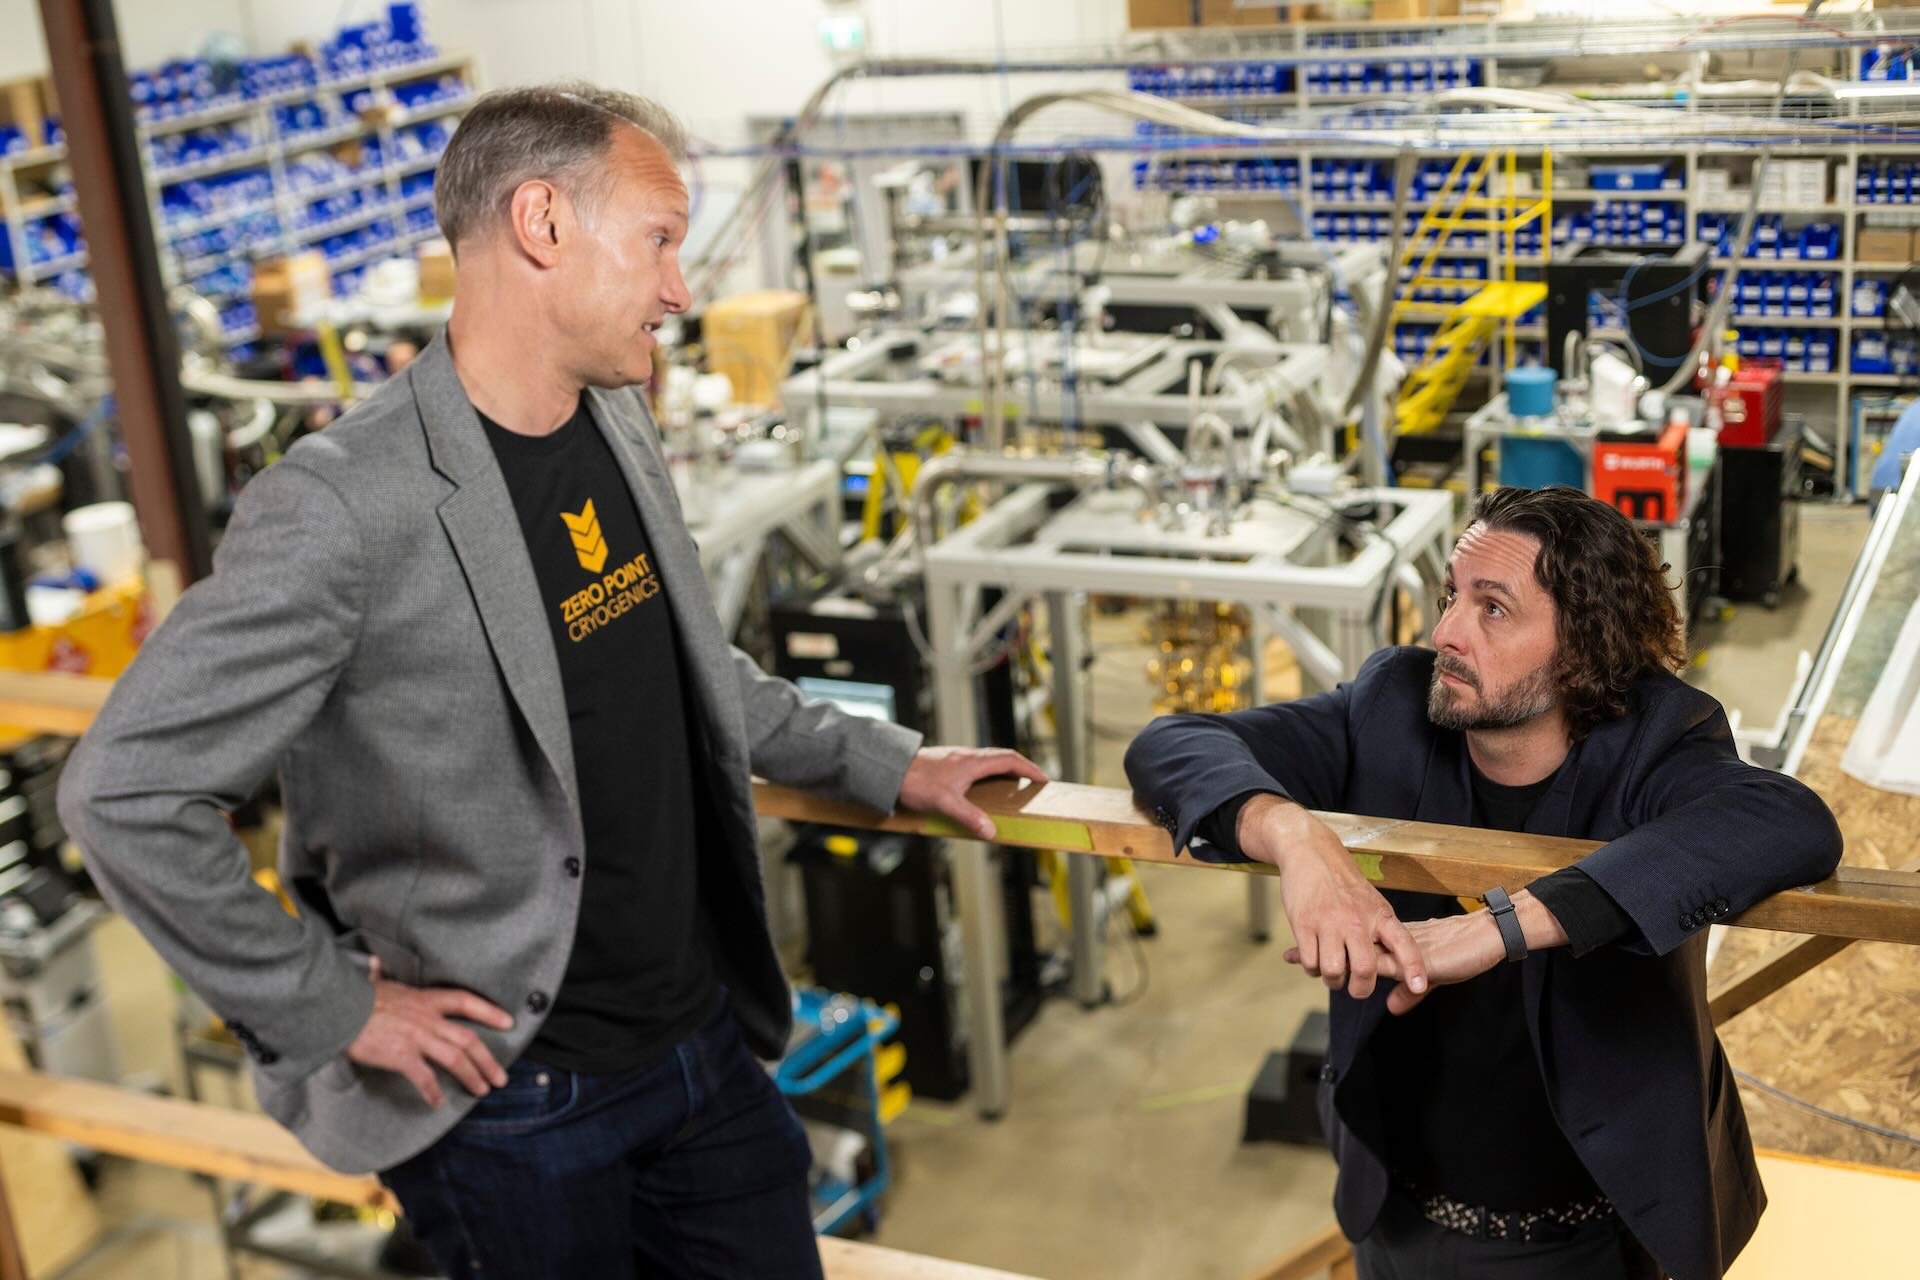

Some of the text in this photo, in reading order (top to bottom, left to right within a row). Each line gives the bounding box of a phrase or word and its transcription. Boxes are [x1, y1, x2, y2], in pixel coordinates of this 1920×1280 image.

[560, 553, 650, 623] ZERO POINT
[568, 574, 660, 642] CRYOGENICS
